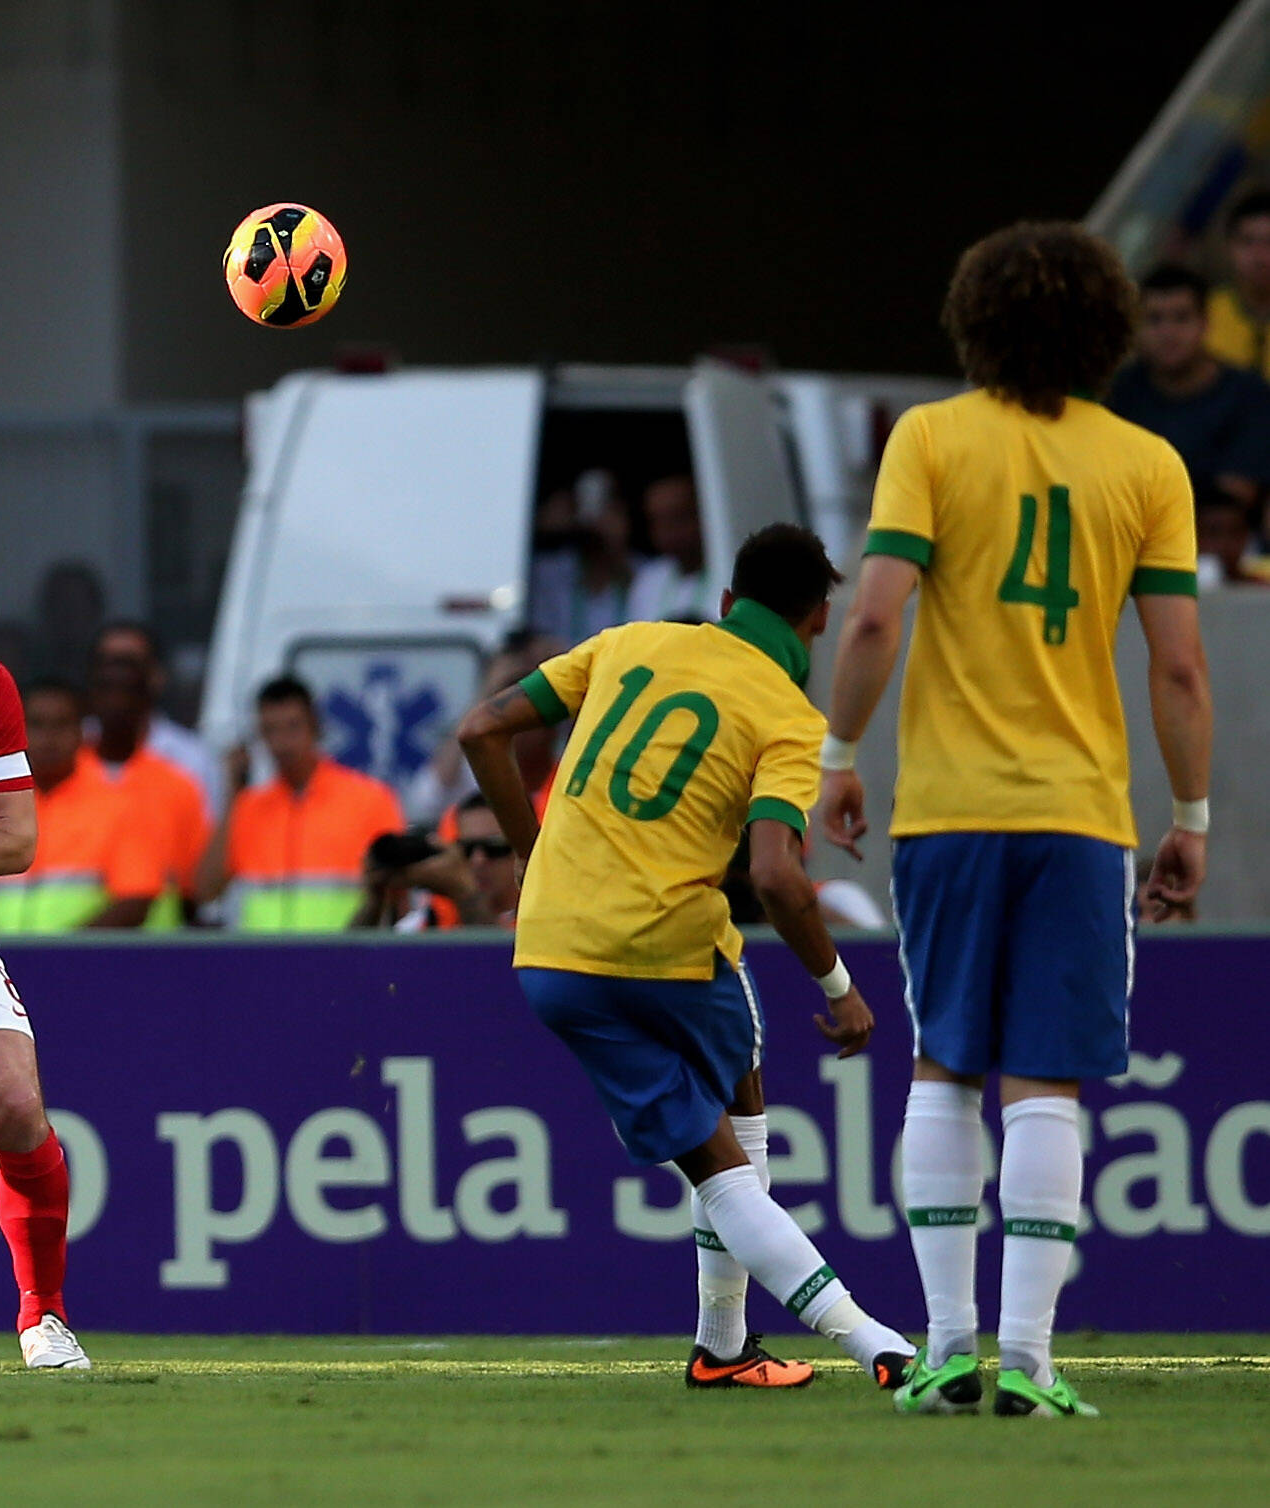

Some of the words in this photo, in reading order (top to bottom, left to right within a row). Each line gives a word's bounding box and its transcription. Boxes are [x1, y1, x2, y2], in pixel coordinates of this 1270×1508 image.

[998, 485, 1079, 645] 4
[565, 665, 719, 822] 10
[155, 1055, 569, 1289] pela
[613, 1051, 1270, 1288] elão
[792, 1272, 828, 1309] BRASIL
